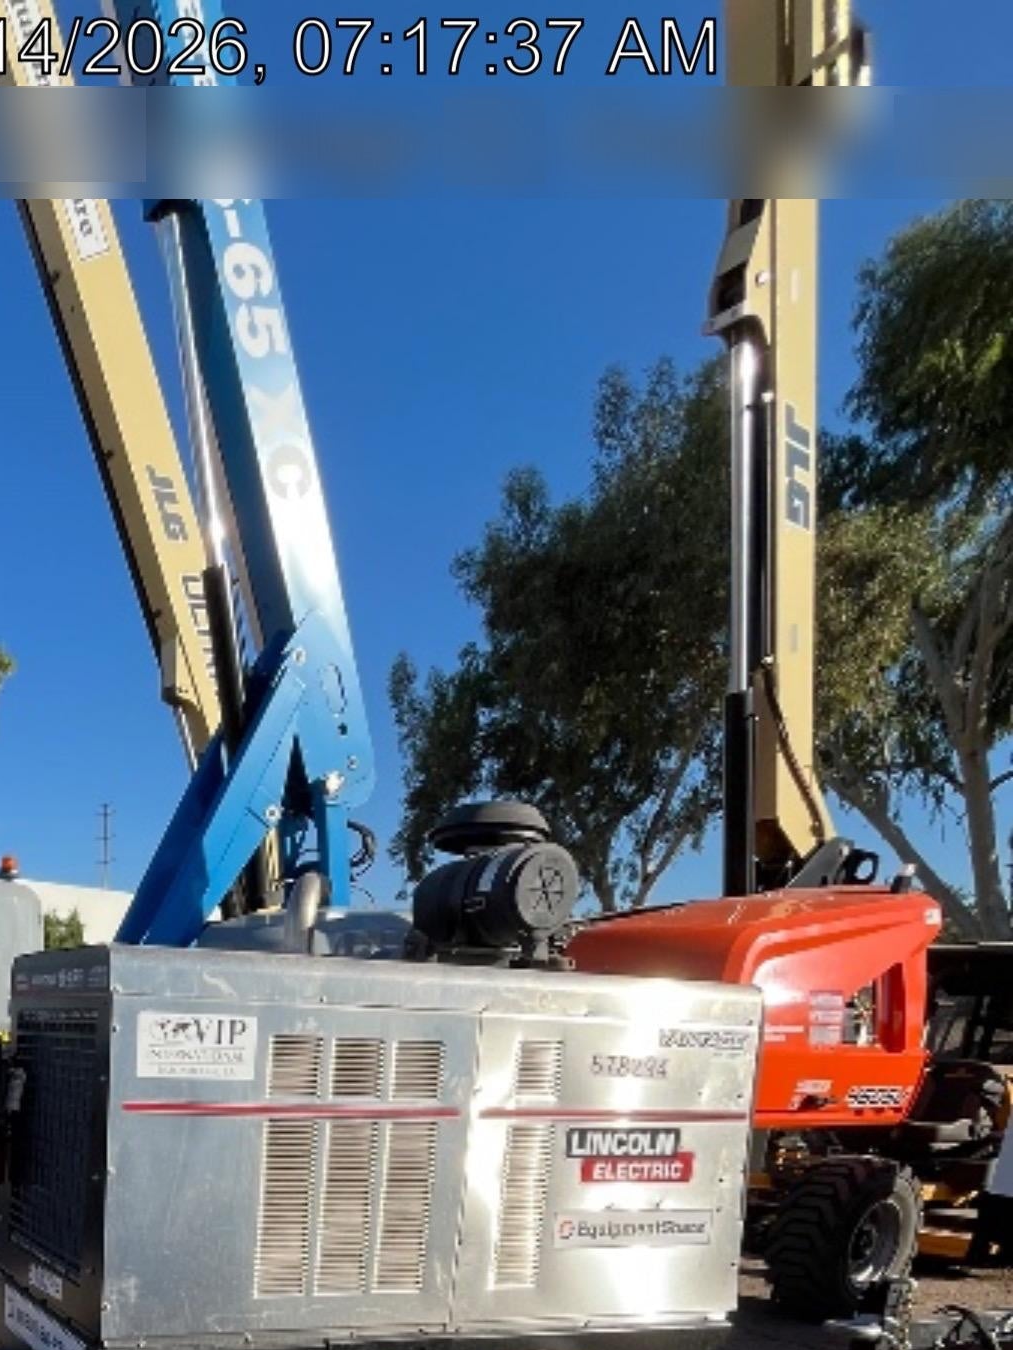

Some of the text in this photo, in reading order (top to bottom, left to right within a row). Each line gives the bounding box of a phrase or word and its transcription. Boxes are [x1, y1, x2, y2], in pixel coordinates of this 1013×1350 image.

[214, 199, 313, 500] -65 XC
[785, 402, 811, 531] JLG
[146, 465, 188, 541] JLG
[191, 1017, 247, 1046] VIP
[570, 1132, 677, 1156] LINCOLN
[592, 1161, 685, 1181] ELECTRIC
